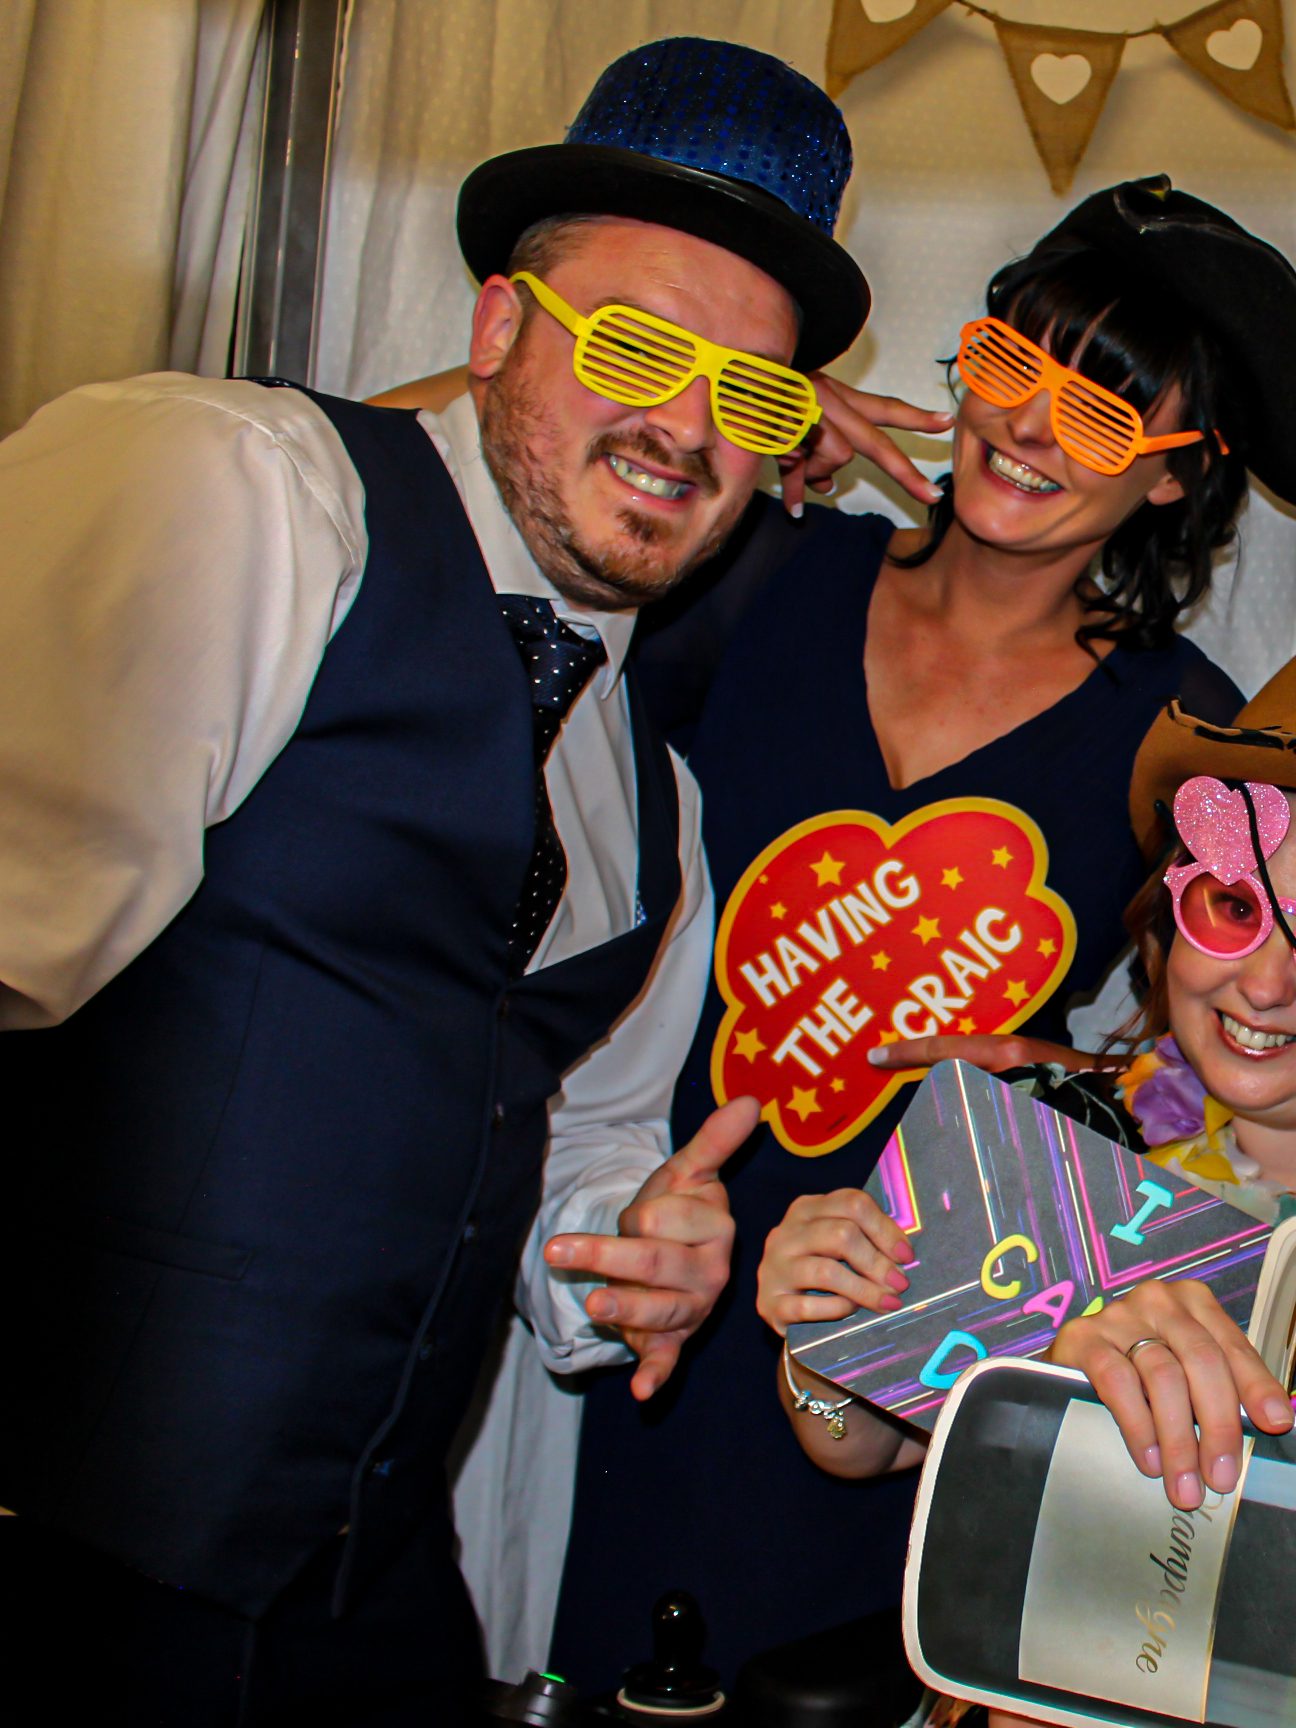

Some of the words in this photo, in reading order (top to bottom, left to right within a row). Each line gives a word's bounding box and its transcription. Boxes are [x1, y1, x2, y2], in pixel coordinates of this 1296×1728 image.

[739, 859, 921, 1008] HAVING
[772, 978, 874, 1077] THE
[891, 907, 1022, 1040] CRAIC
[1135, 1494, 1224, 1674] ampagne
